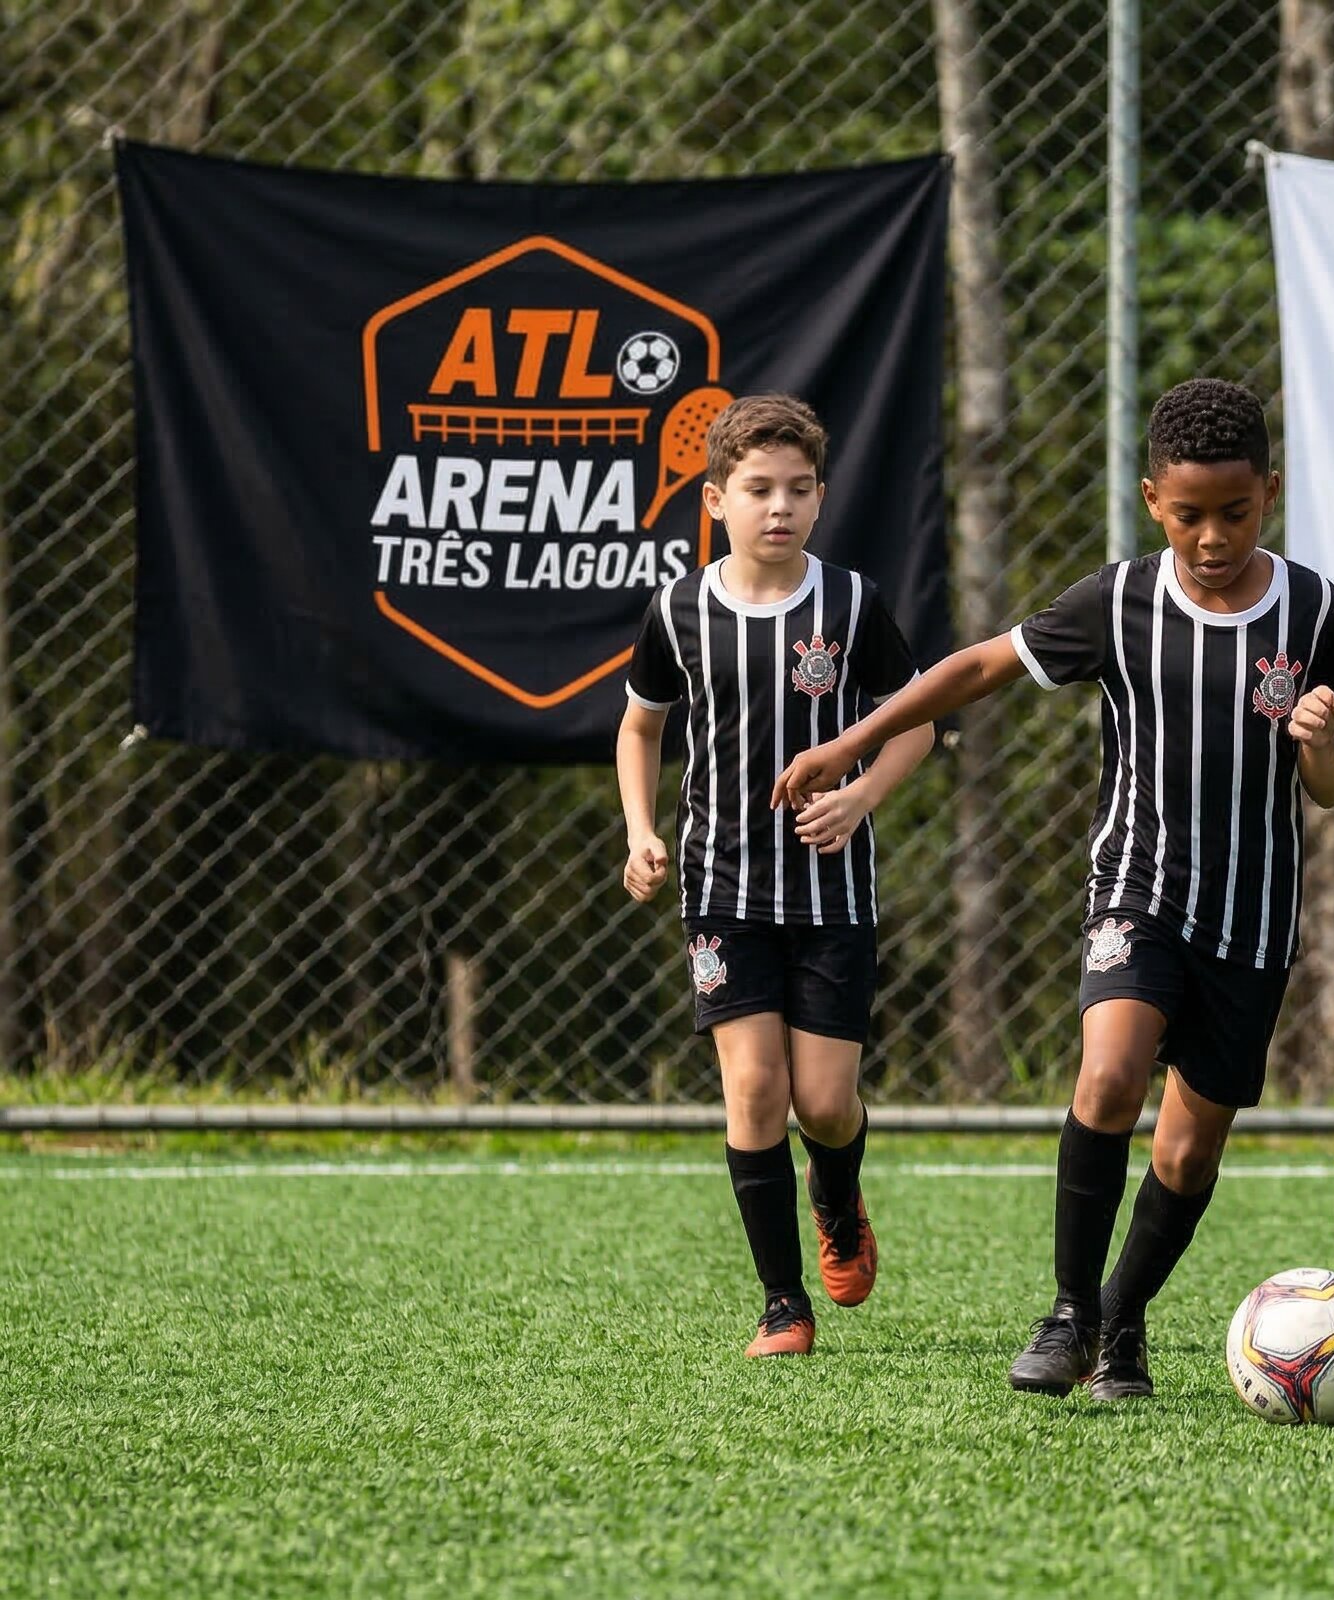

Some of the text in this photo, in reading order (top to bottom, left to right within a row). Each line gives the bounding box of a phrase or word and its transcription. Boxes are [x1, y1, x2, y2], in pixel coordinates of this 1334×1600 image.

[428, 307, 614, 398] ATL
[370, 454, 636, 533] ARENA
[372, 530, 691, 589] TRÊS LAGOAS
